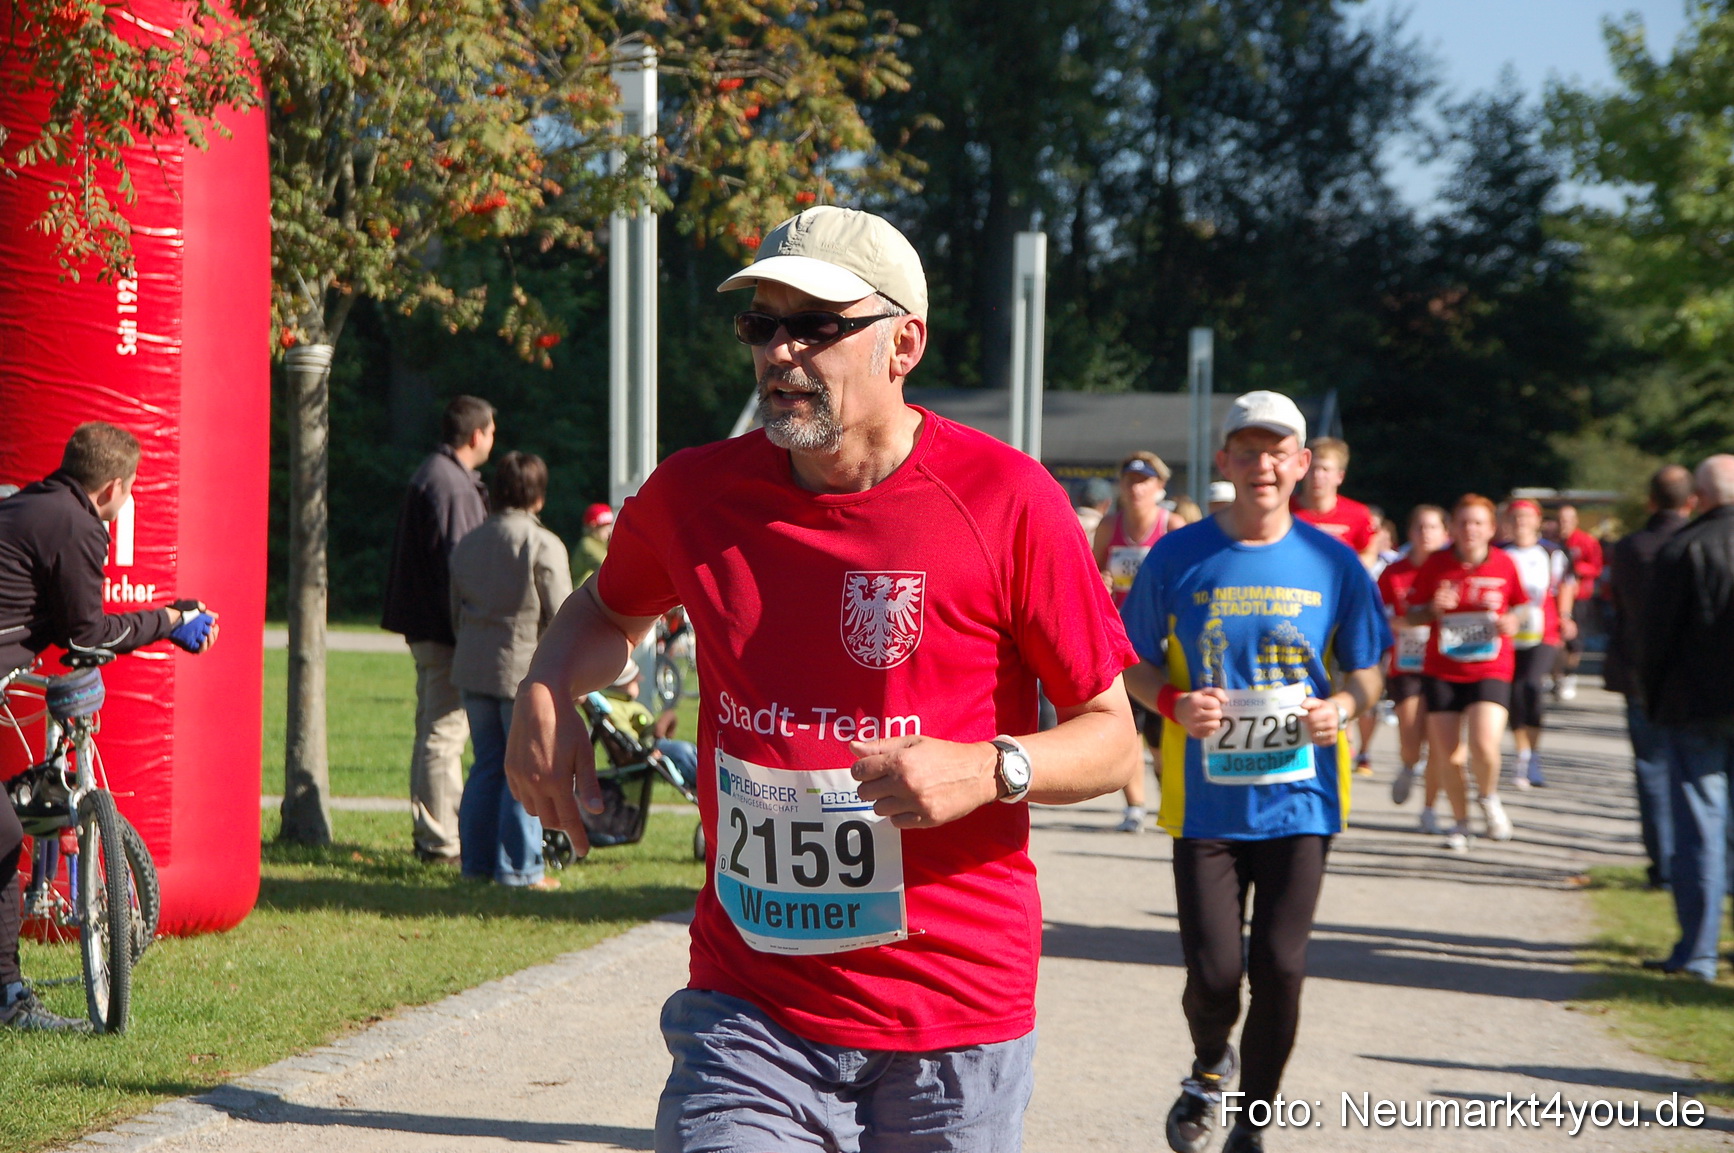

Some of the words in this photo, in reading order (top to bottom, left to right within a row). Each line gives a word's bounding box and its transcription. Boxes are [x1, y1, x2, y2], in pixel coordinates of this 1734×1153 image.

[117, 268, 138, 314] 192
[116, 319, 137, 355] Seit
[102, 574, 156, 603] icher
[1213, 586, 1322, 606] NEUMARKTER
[1209, 602, 1303, 617] STADTLAUF
[718, 691, 921, 742] Stadt-Team
[1218, 714, 1300, 749] 2729
[731, 773, 798, 803] PFLEIDERER
[821, 791, 877, 805] BOC
[729, 807, 876, 888] 2159
[739, 884, 861, 930] Werner
